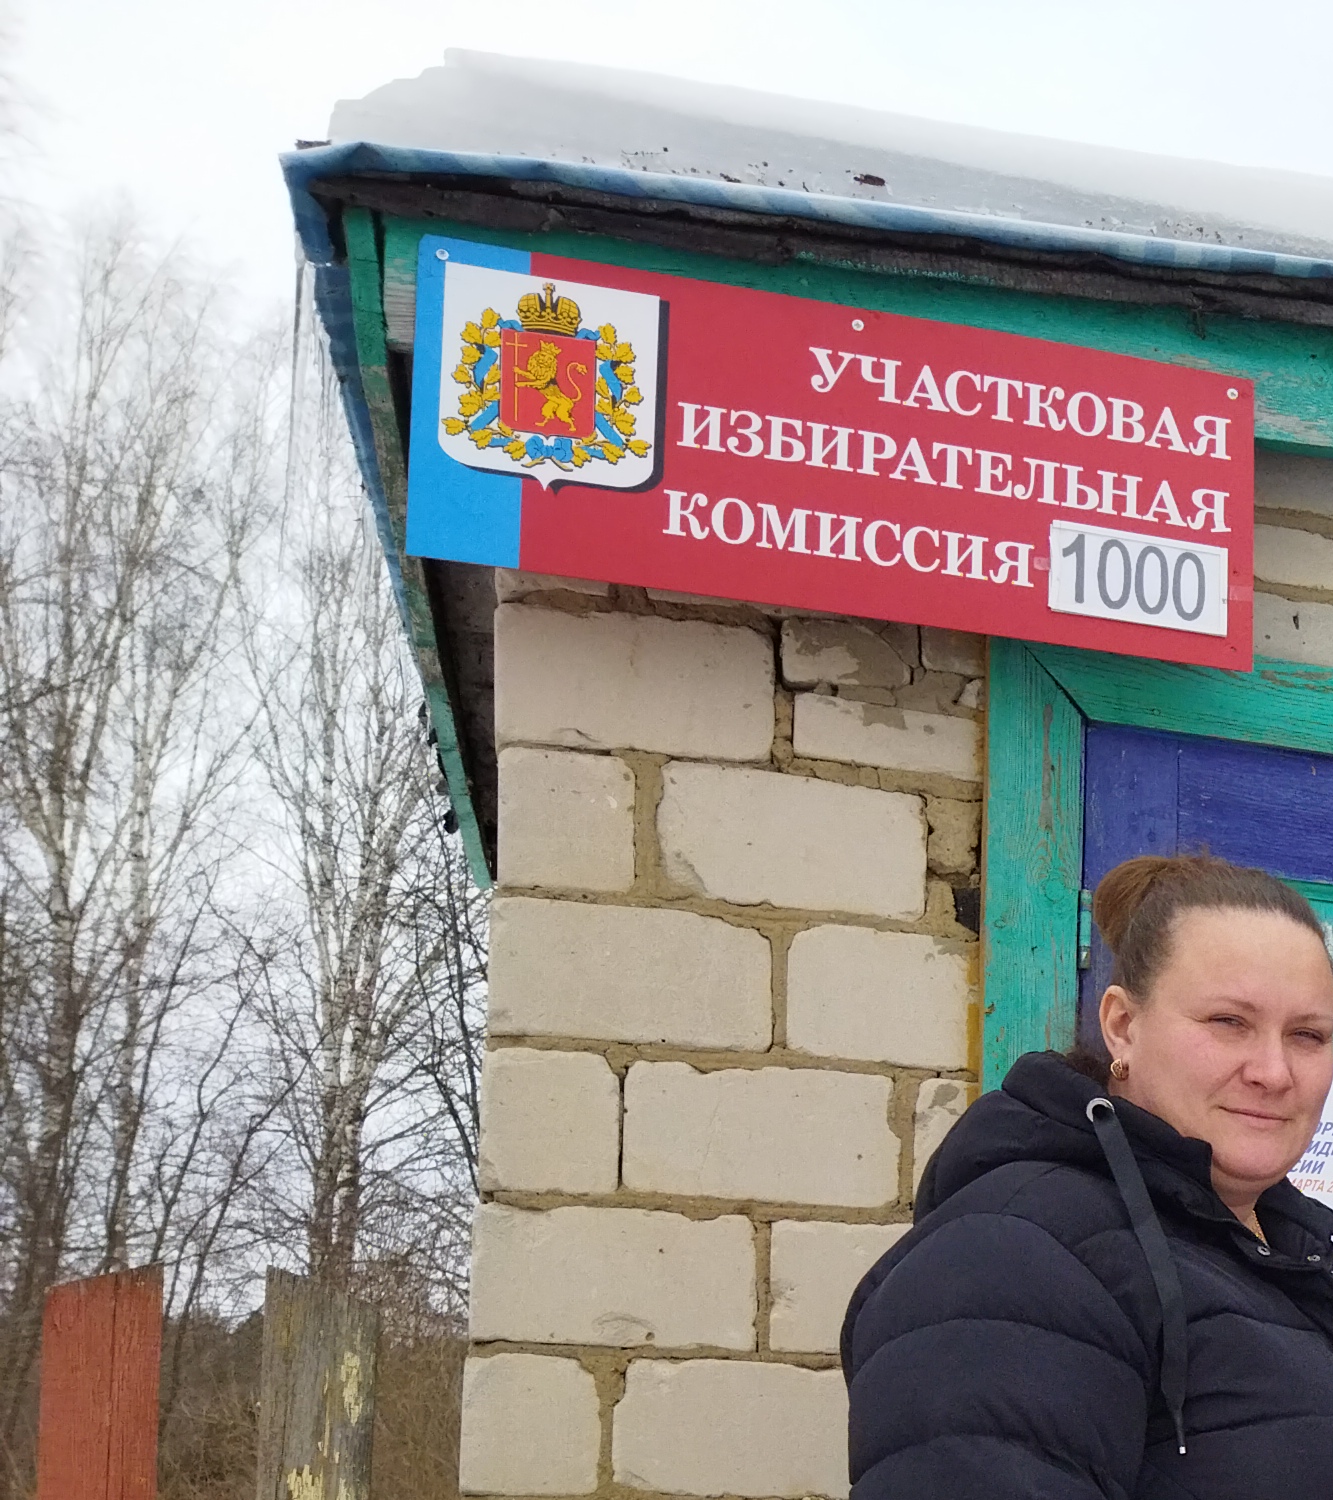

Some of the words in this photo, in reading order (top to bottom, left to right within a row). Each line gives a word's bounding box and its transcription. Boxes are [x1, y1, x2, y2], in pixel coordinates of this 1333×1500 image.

[809, 347, 1232, 461] УЧАСТКОВАЯ
[676, 402, 1231, 533] ИЗБИРАТЕЛЬНАЯ
[662, 489, 1035, 588] КОМИССИЯ
[1061, 533, 1204, 622] 1000
[1287, 1159, 1325, 1175] СИИ
